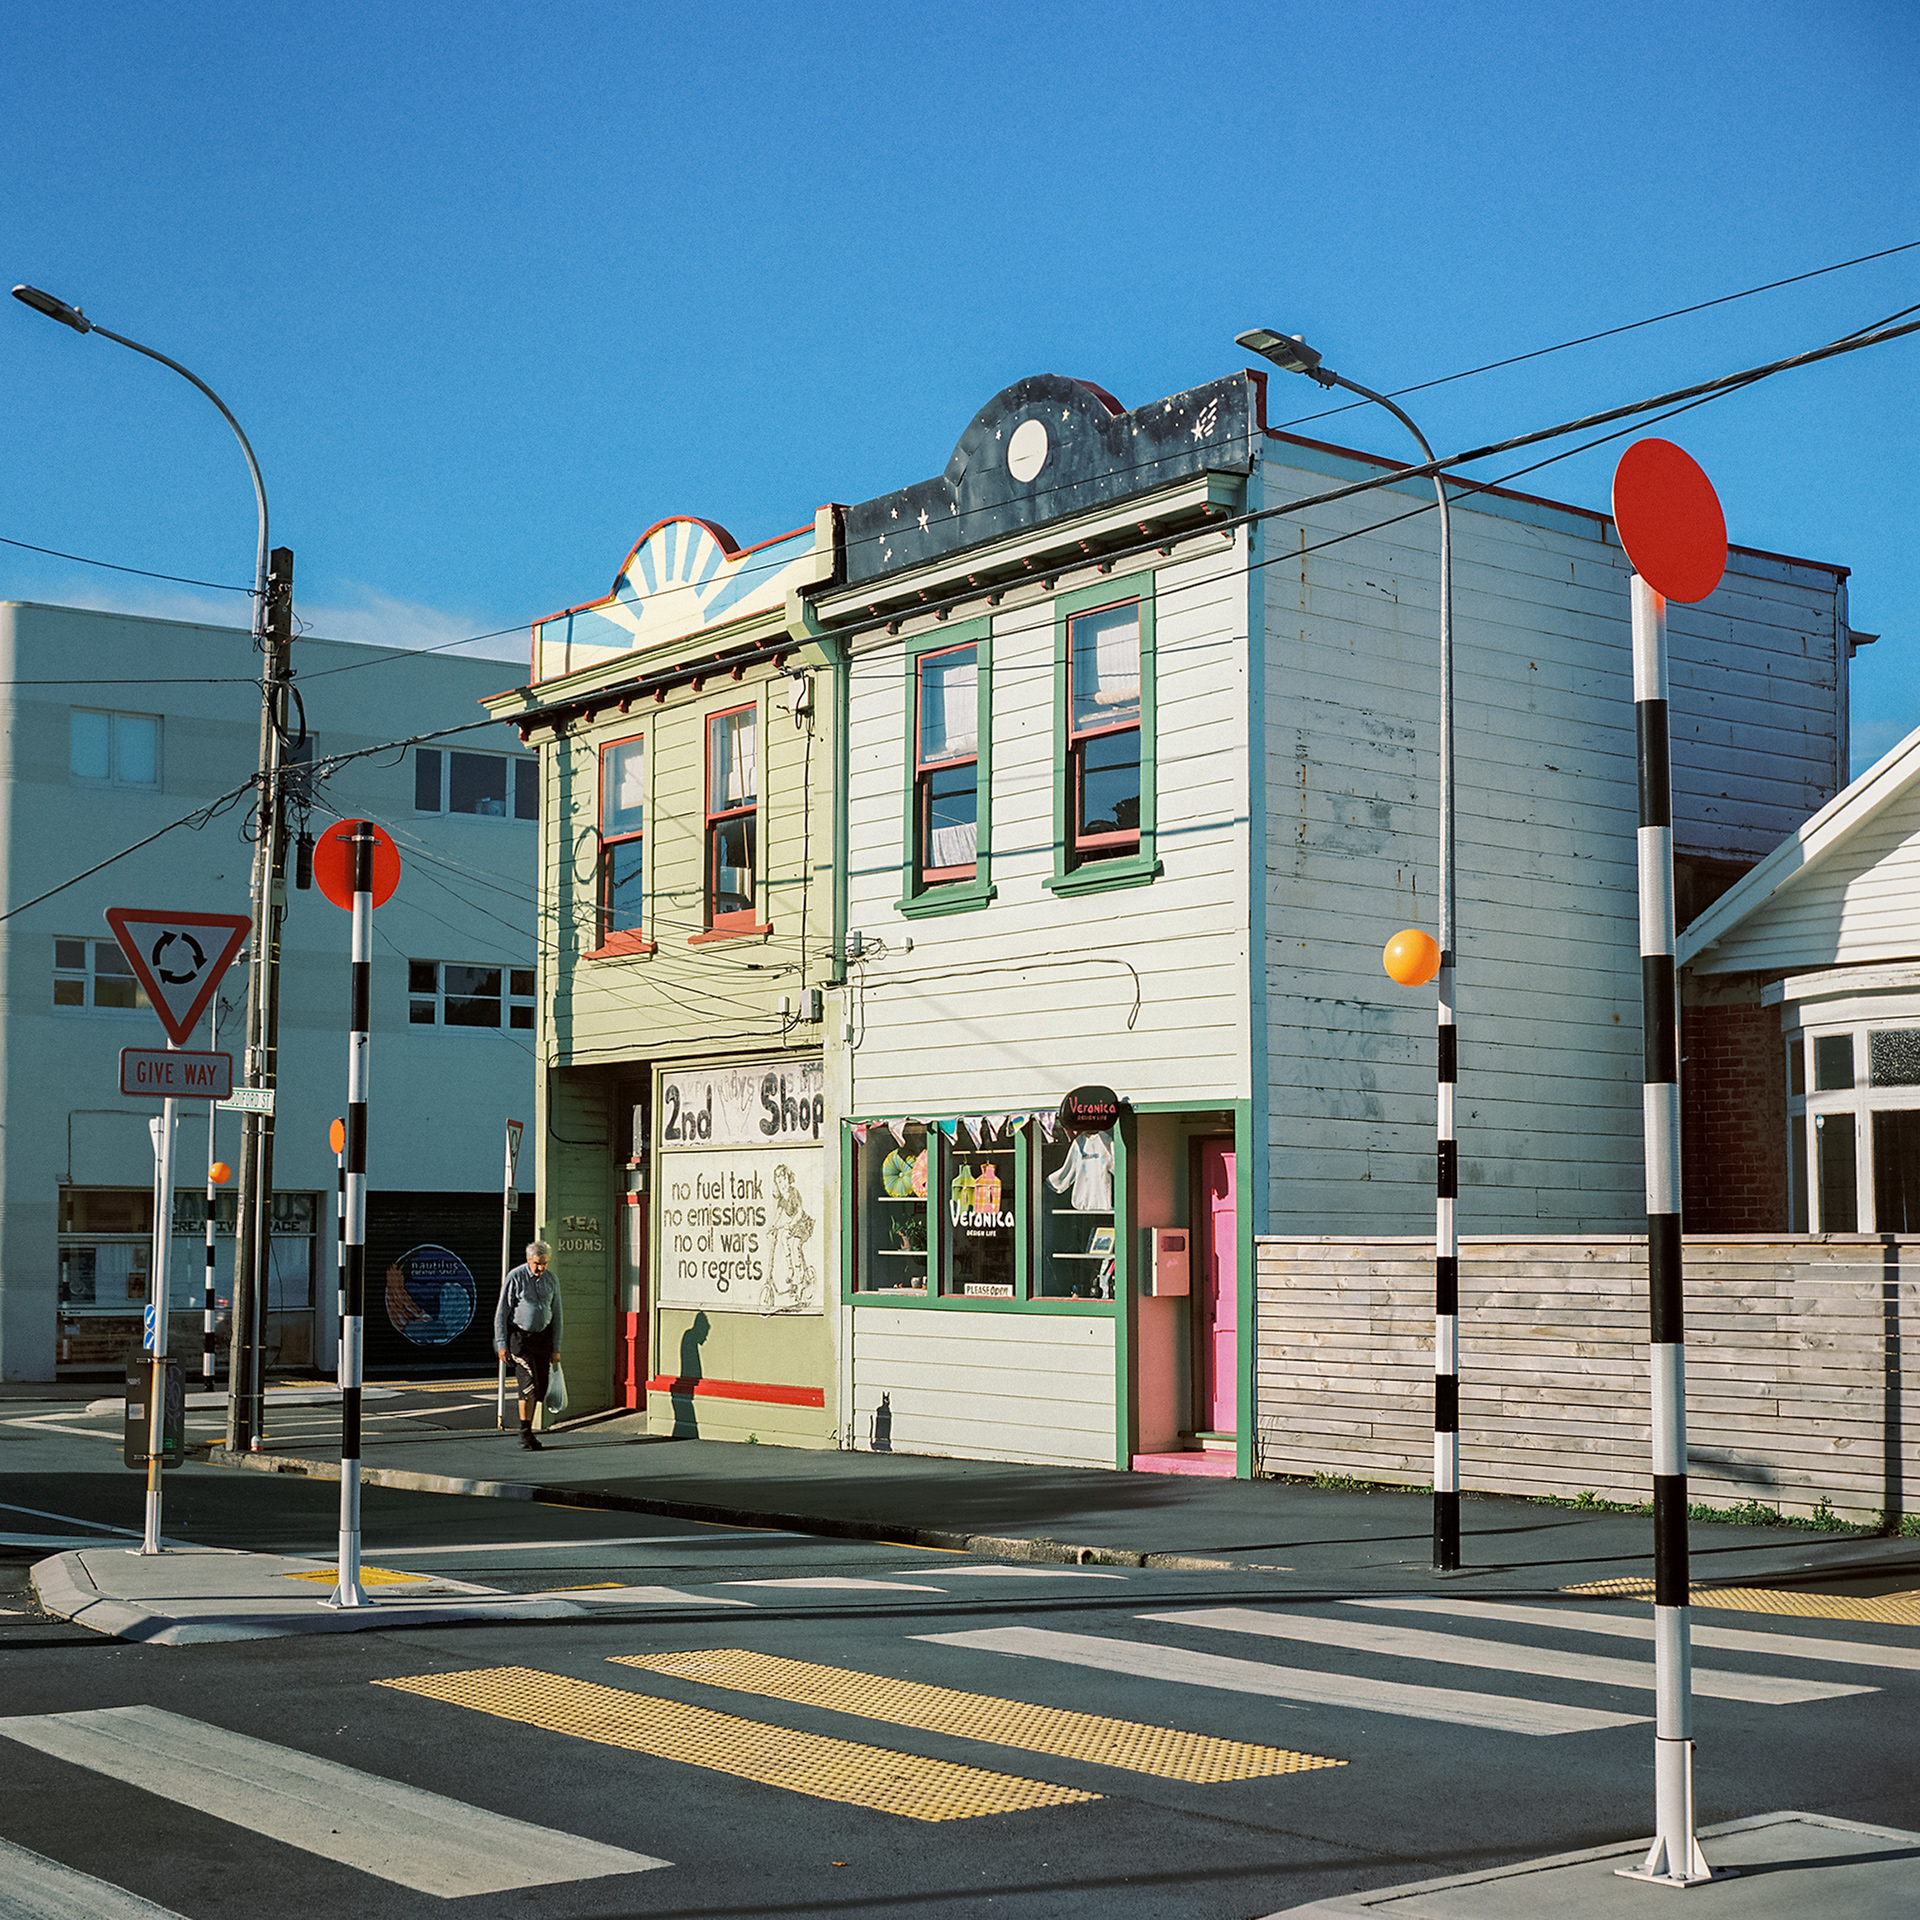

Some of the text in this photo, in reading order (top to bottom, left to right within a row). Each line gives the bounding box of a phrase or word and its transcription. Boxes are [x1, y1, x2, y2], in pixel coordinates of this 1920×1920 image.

[137, 1061, 217, 1086] GIVE WAY
[222, 1091, 270, 1108] DDIFORD ST
[665, 1084, 712, 1141] 2nd
[759, 1072, 824, 1140] Shop
[1069, 1096, 1117, 1114] Veronica
[672, 1170, 764, 1200] no fuel tank
[562, 1215, 599, 1231] TEA
[663, 1201, 767, 1227] no emissions
[949, 1198, 1015, 1228] Veronica
[674, 1227, 759, 1253] no oil wars
[411, 1259, 458, 1270] nautilus
[678, 1253, 763, 1293] no regrets
[966, 1285, 990, 1295] PLEASE
